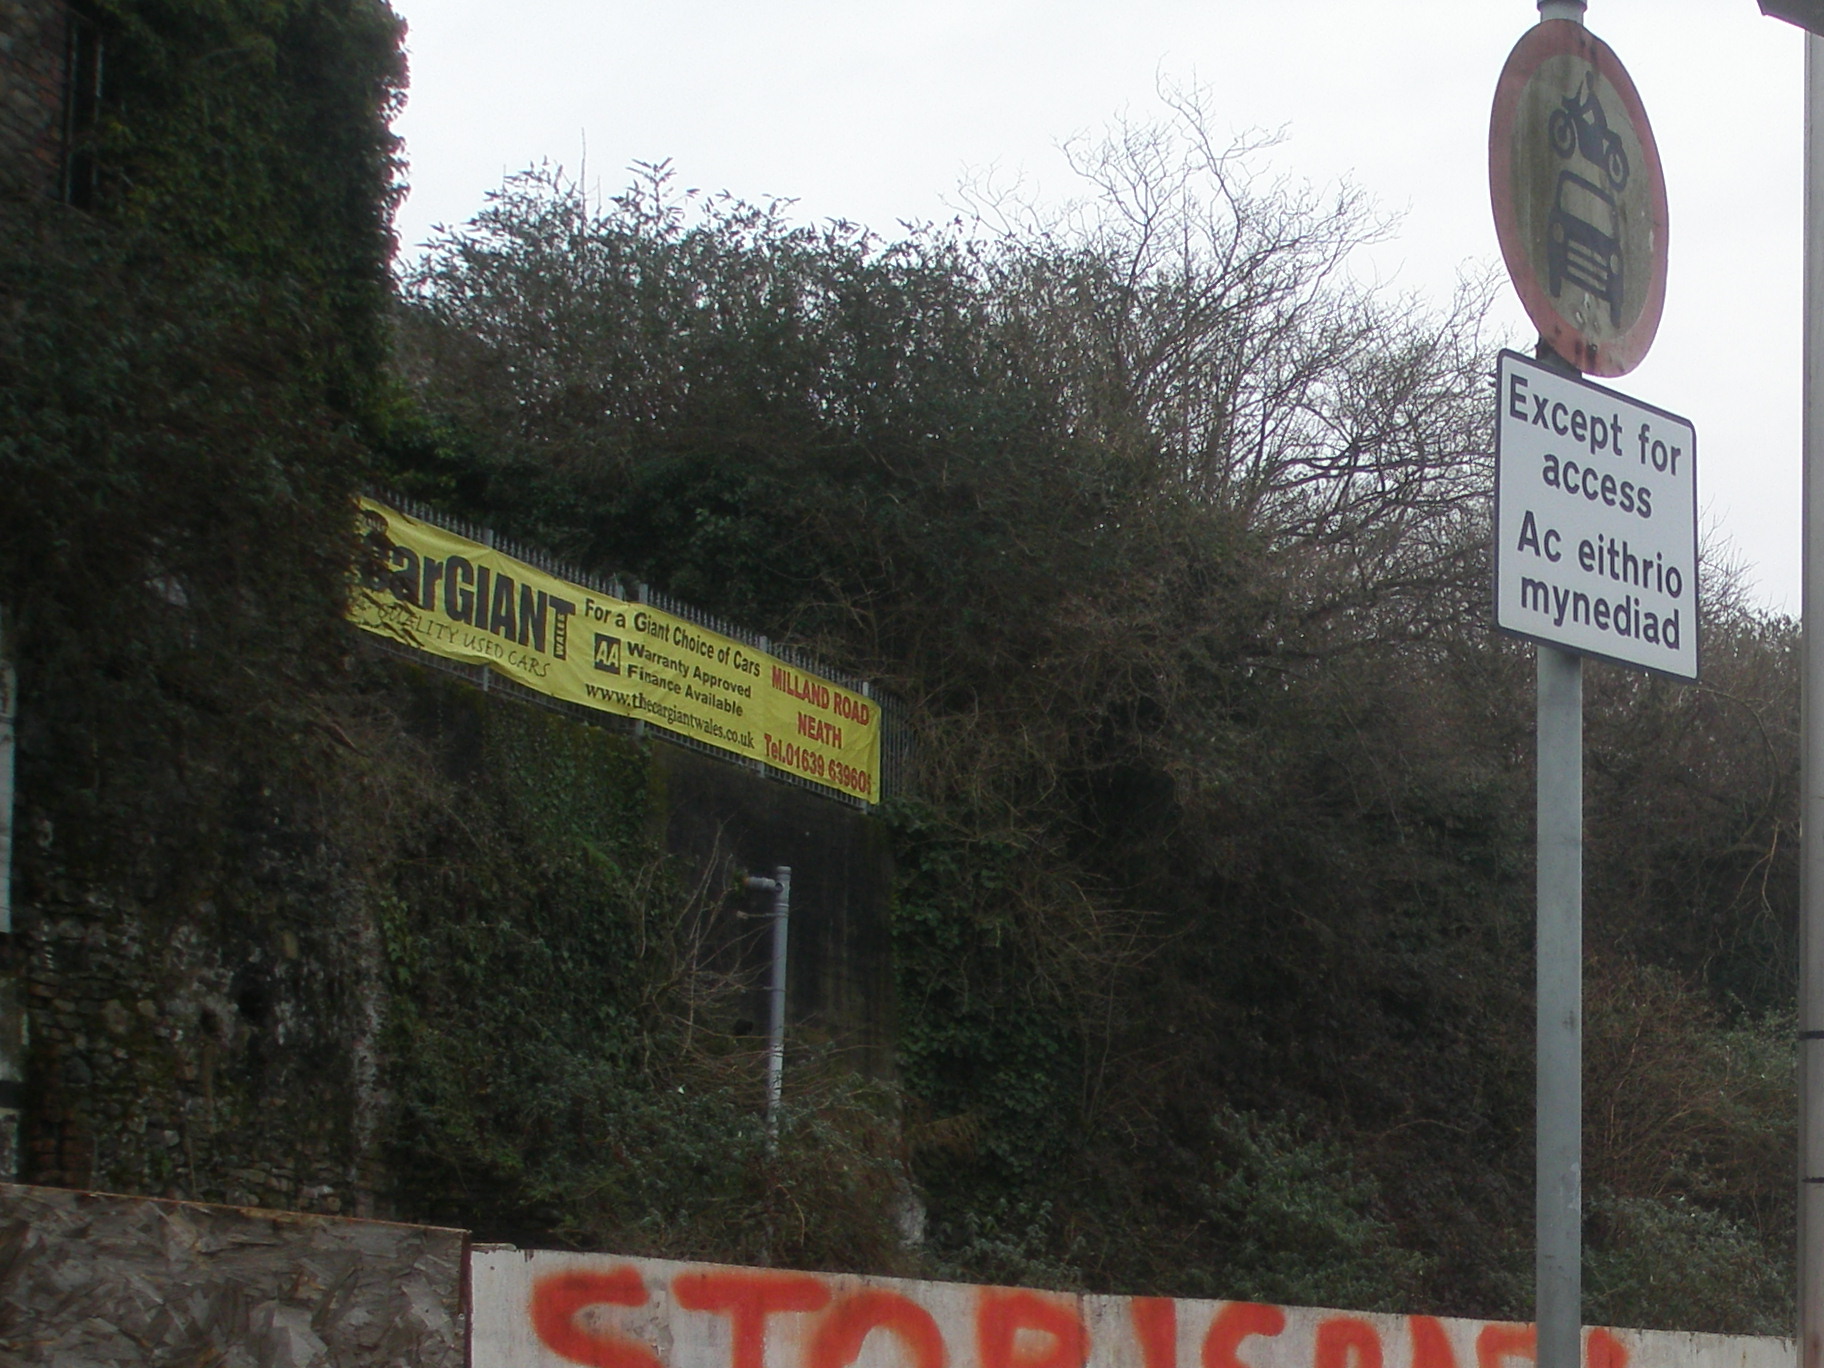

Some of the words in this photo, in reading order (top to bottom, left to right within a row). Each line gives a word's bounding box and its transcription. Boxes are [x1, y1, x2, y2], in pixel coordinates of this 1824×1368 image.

[1509, 373, 1623, 456] Except
[1638, 423, 1682, 476] for
[1542, 453, 1652, 519] access
[1517, 510, 1562, 563] Ac
[1578, 533, 1683, 599] eithrio
[555, 613, 566, 656] WALES
[585, 597, 611, 623] For
[615, 613, 626, 629] a
[634, 612, 670, 642] Giant
[673, 626, 714, 659] Choice
[717, 646, 730, 666] of
[733, 650, 761, 678] Cars
[1521, 576, 1681, 651] mynediad
[463, 632, 504, 659] USED
[508, 650, 551, 678] CARS
[595, 639, 620, 668] AA
[627, 640, 690, 678] Warranty
[692, 666, 752, 699] Approved
[585, 683, 755, 750] www.thecargiantwales.co.uk
[627, 663, 682, 695] Finance
[684, 685, 744, 717] Available
[771, 664, 830, 710] MILLAND
[833, 691, 870, 726] ROAD
[764, 733, 825, 777] Tel.01639
[797, 711, 843, 749] NEATH
